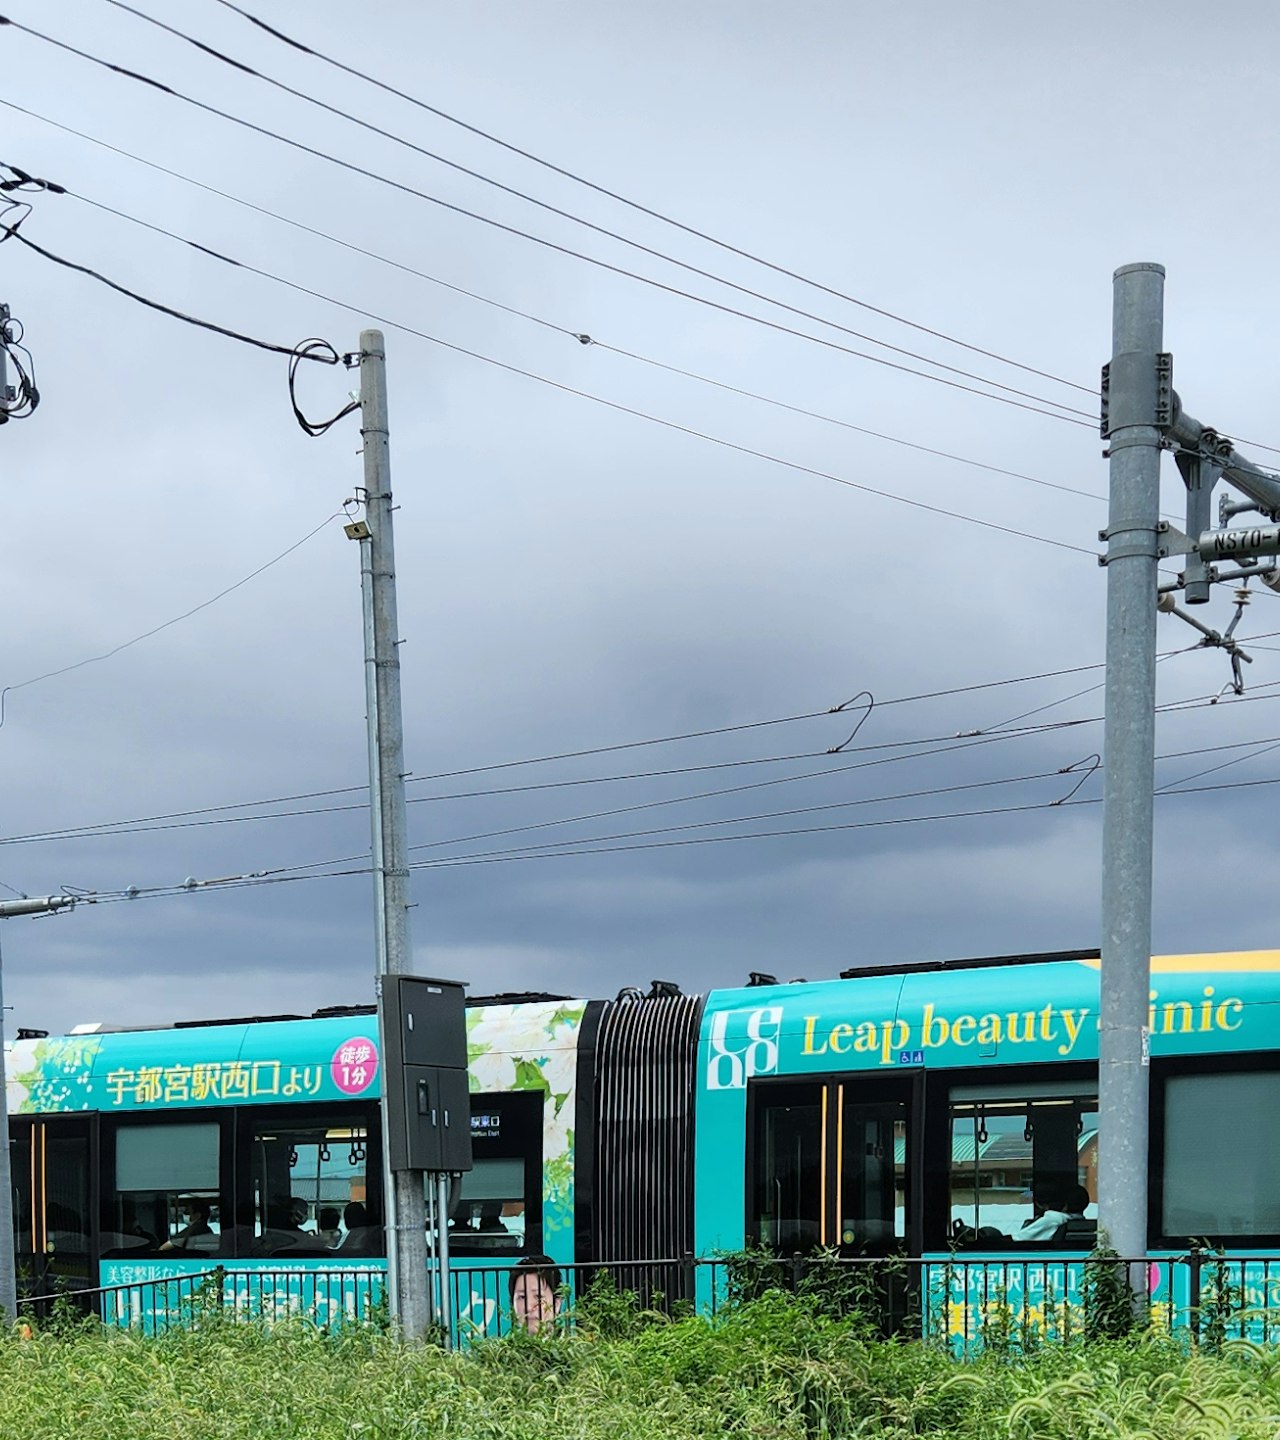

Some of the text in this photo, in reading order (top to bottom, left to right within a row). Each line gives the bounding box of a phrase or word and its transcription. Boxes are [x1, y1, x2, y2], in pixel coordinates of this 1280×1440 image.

[800, 1015, 910, 1065] Leap
[921, 1003, 1090, 1054] beauty
[1097, 986, 1244, 1035] inic
[340, 1045, 371, 1065] 徒歩
[106, 1060, 323, 1105] 宇都宮駅西口より
[342, 1066, 367, 1086] 1分
